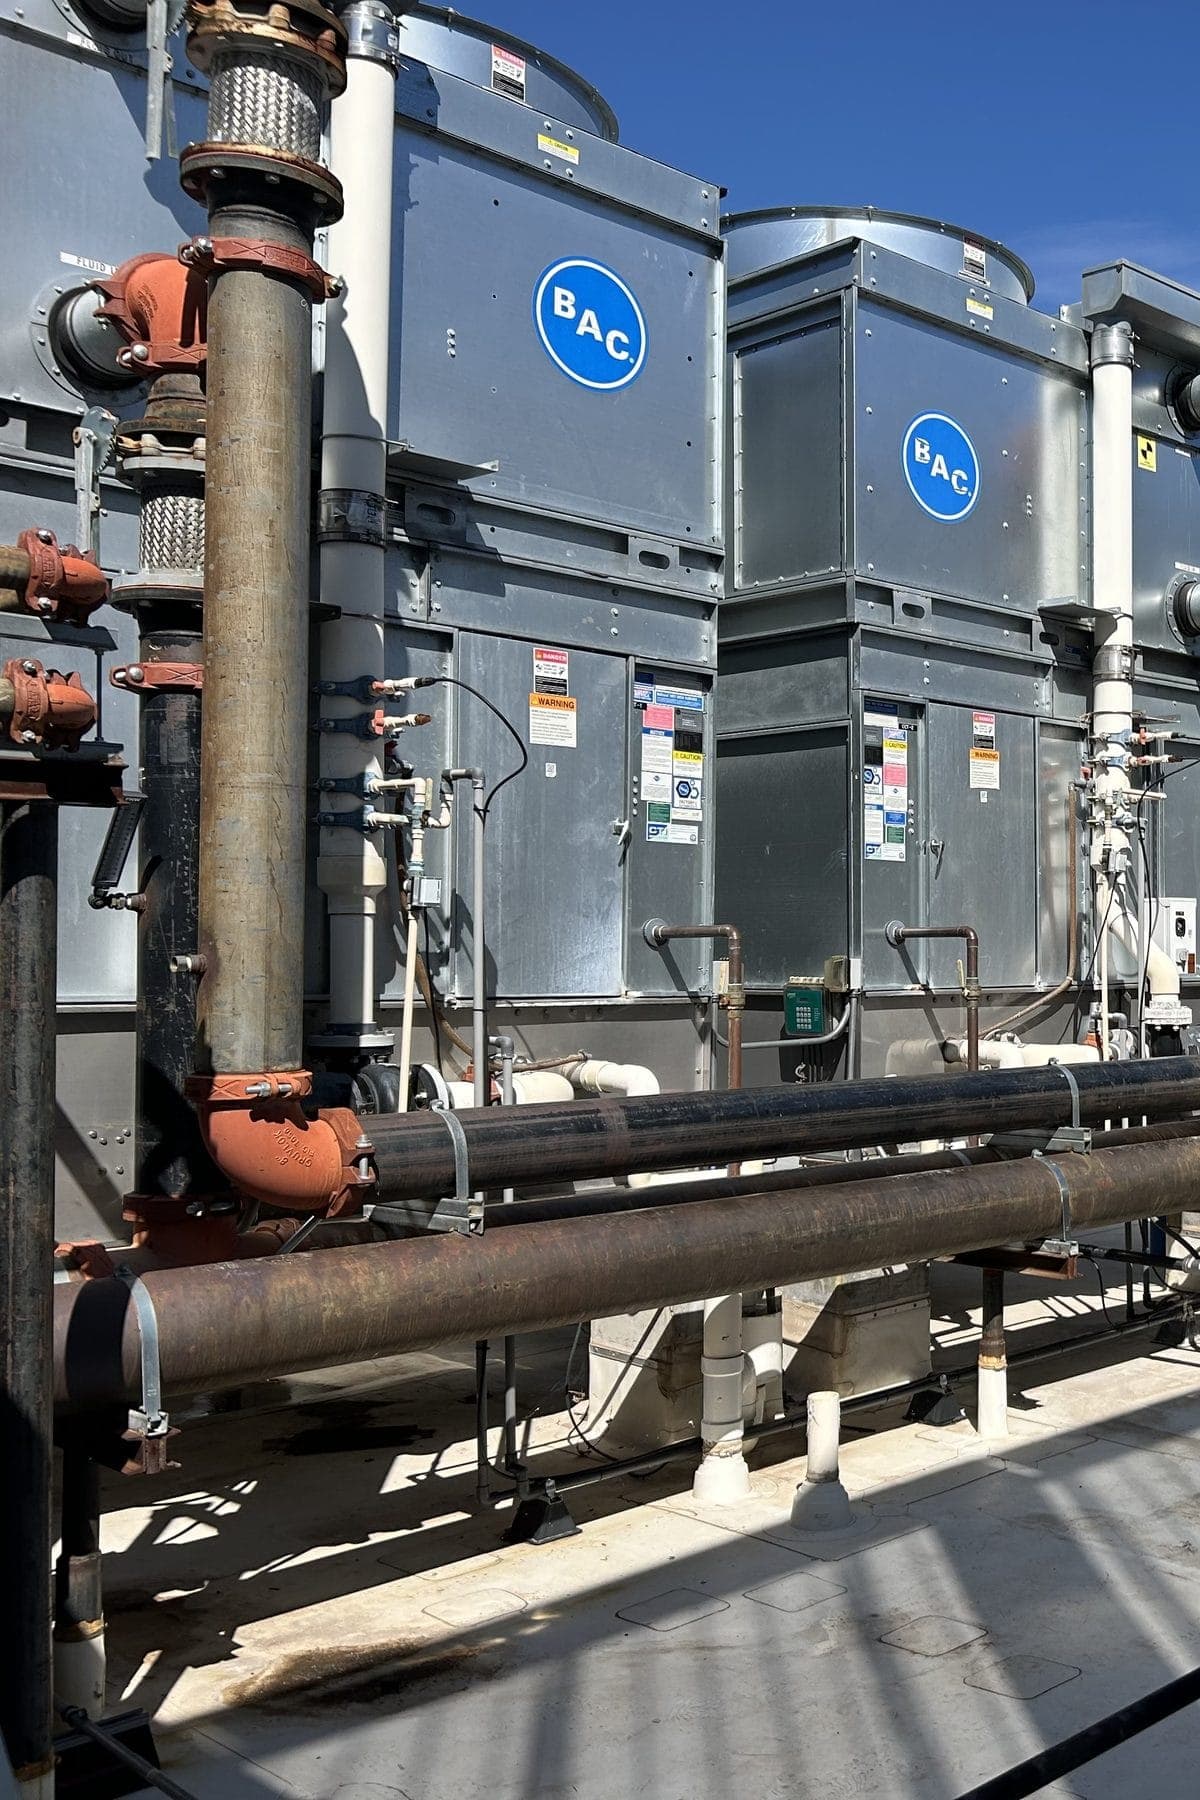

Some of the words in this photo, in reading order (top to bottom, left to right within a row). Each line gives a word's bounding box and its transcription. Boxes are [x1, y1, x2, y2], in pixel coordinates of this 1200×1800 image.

[538, 697, 575, 709] WARNING
[680, 752, 701, 760] CAUTION
[273, 1130, 313, 1168] GRUVLOK
